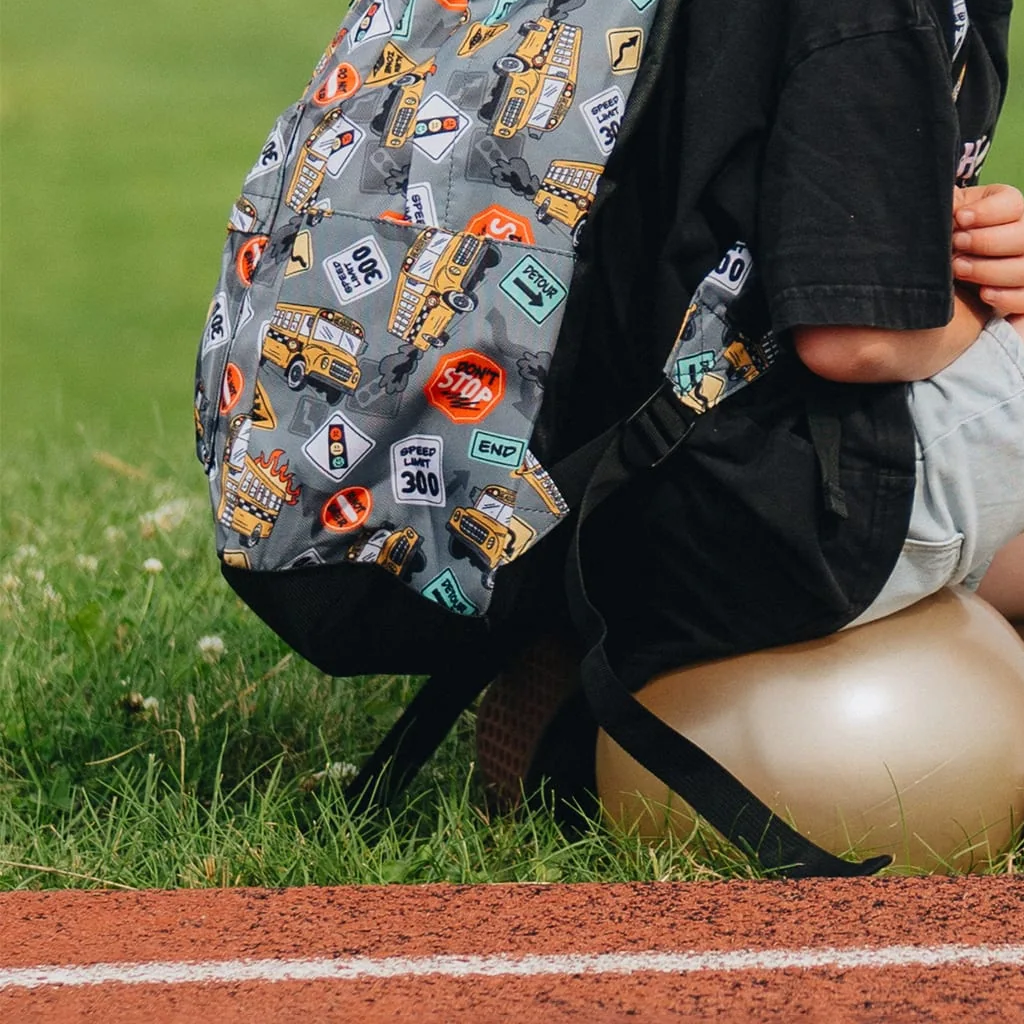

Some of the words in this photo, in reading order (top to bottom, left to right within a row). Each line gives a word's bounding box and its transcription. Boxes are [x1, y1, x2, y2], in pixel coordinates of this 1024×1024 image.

[591, 95, 619, 116] SPEED
[599, 116, 624, 146] 30
[411, 193, 425, 225] SPEE
[333, 261, 353, 294] SPEED
[343, 262, 361, 288] LIMIT
[352, 245, 383, 285] 300
[714, 254, 746, 282] 00
[522, 265, 558, 299] DETOUR
[438, 367, 493, 407] STOP
[455, 361, 499, 386] DON'T
[400, 445, 436, 457] SPEED
[403, 457, 431, 469] LIMIT
[478, 440, 517, 458] END
[400, 470, 440, 497] 300
[441, 578, 468, 614] DETOUR
